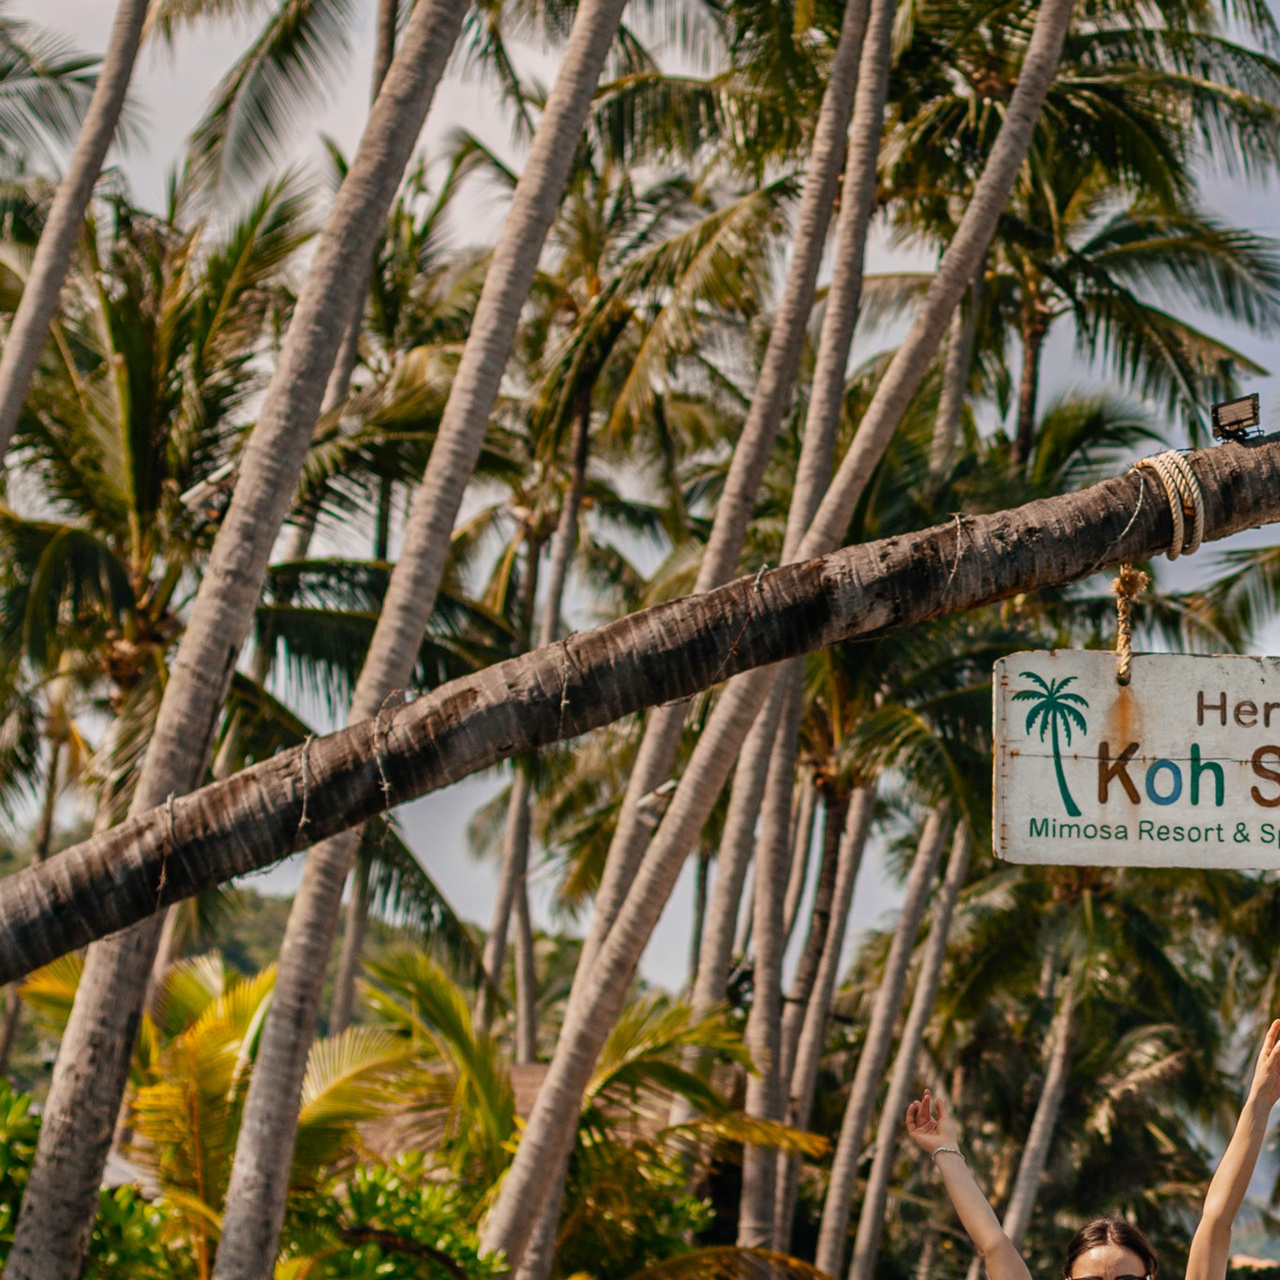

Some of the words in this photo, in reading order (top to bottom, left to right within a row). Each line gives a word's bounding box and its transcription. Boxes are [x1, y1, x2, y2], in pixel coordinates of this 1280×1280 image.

[1098, 741, 1225, 807] Koh
[1028, 818, 1128, 841] Mimosa
[1139, 820, 1224, 843] Resort
[1233, 823, 1250, 843] &
